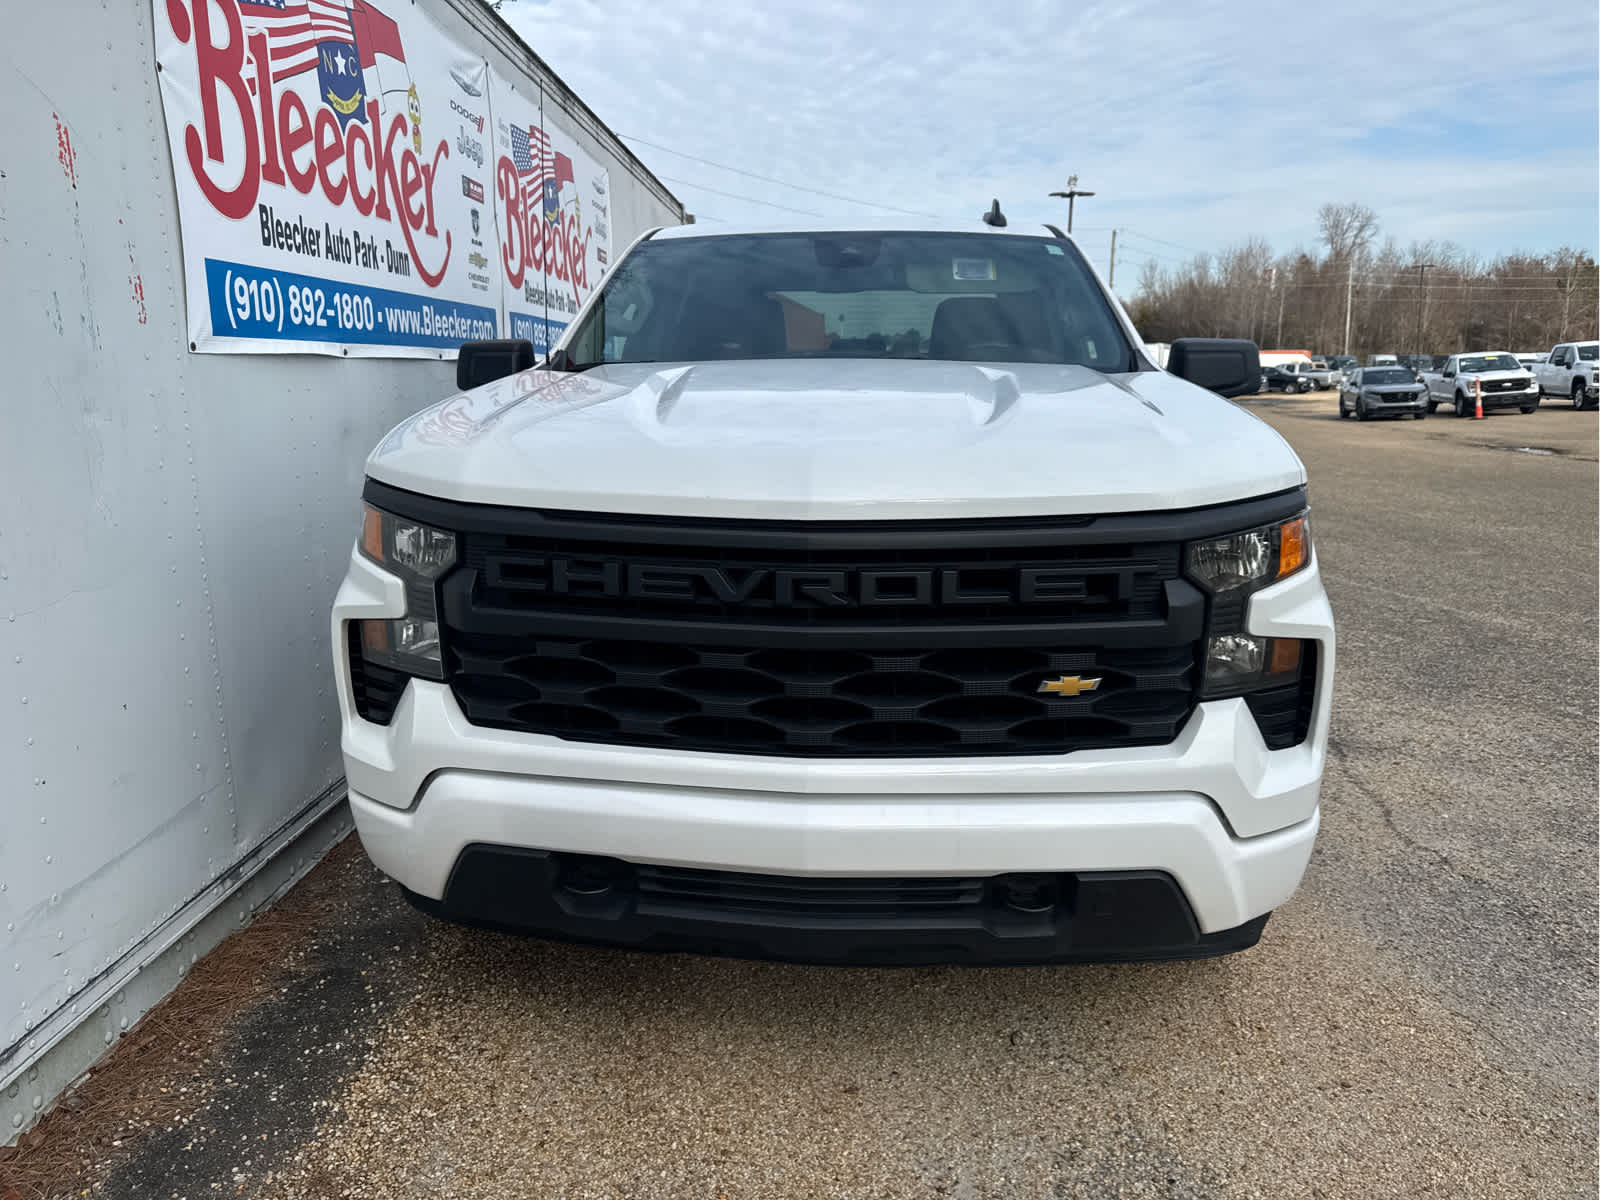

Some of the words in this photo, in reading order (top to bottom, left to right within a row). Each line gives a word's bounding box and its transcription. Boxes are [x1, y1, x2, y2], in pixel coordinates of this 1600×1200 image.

[322, 48, 334, 74] N
[348, 56, 358, 77] C
[167, 0, 451, 288] Bleecker
[450, 99, 480, 128] DODGE
[456, 125, 484, 168] Jeep
[258, 203, 321, 258] Bleecker
[324, 222, 352, 265] Auto
[353, 230, 380, 271] Park
[385, 239, 411, 277] Dunn
[498, 155, 593, 308] Bleecker
[224, 269, 285, 333] (910)
[288, 284, 374, 332] 892-1800
[385, 305, 494, 341] www.Bleecker.com
[486, 552, 1158, 608] CHEVROLET
